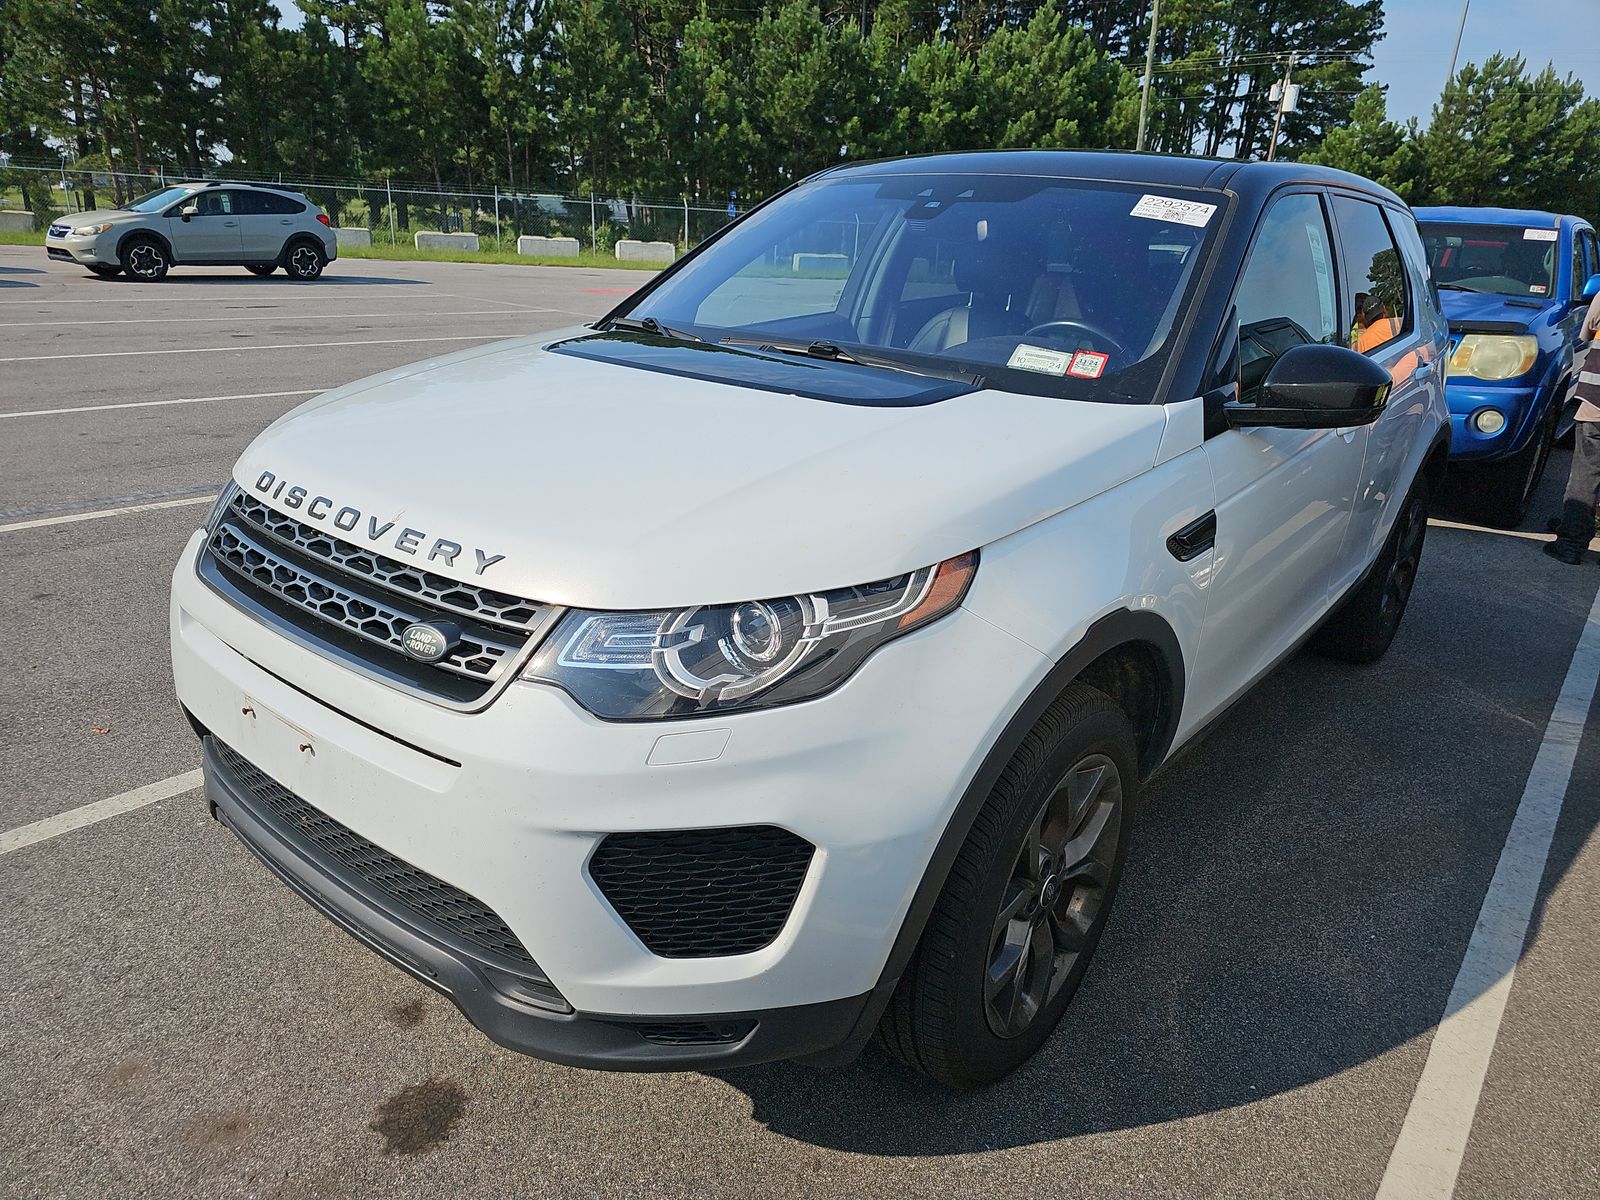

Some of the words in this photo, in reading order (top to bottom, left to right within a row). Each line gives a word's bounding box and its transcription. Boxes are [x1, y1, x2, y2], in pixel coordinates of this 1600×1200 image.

[1144, 197, 1210, 214] 2292574
[1016, 356, 1026, 364] 10
[1049, 361, 1062, 370] 24
[255, 470, 506, 576] DISCOVERY
[410, 630, 432, 644] LAND
[409, 639, 437, 656] ROVER
